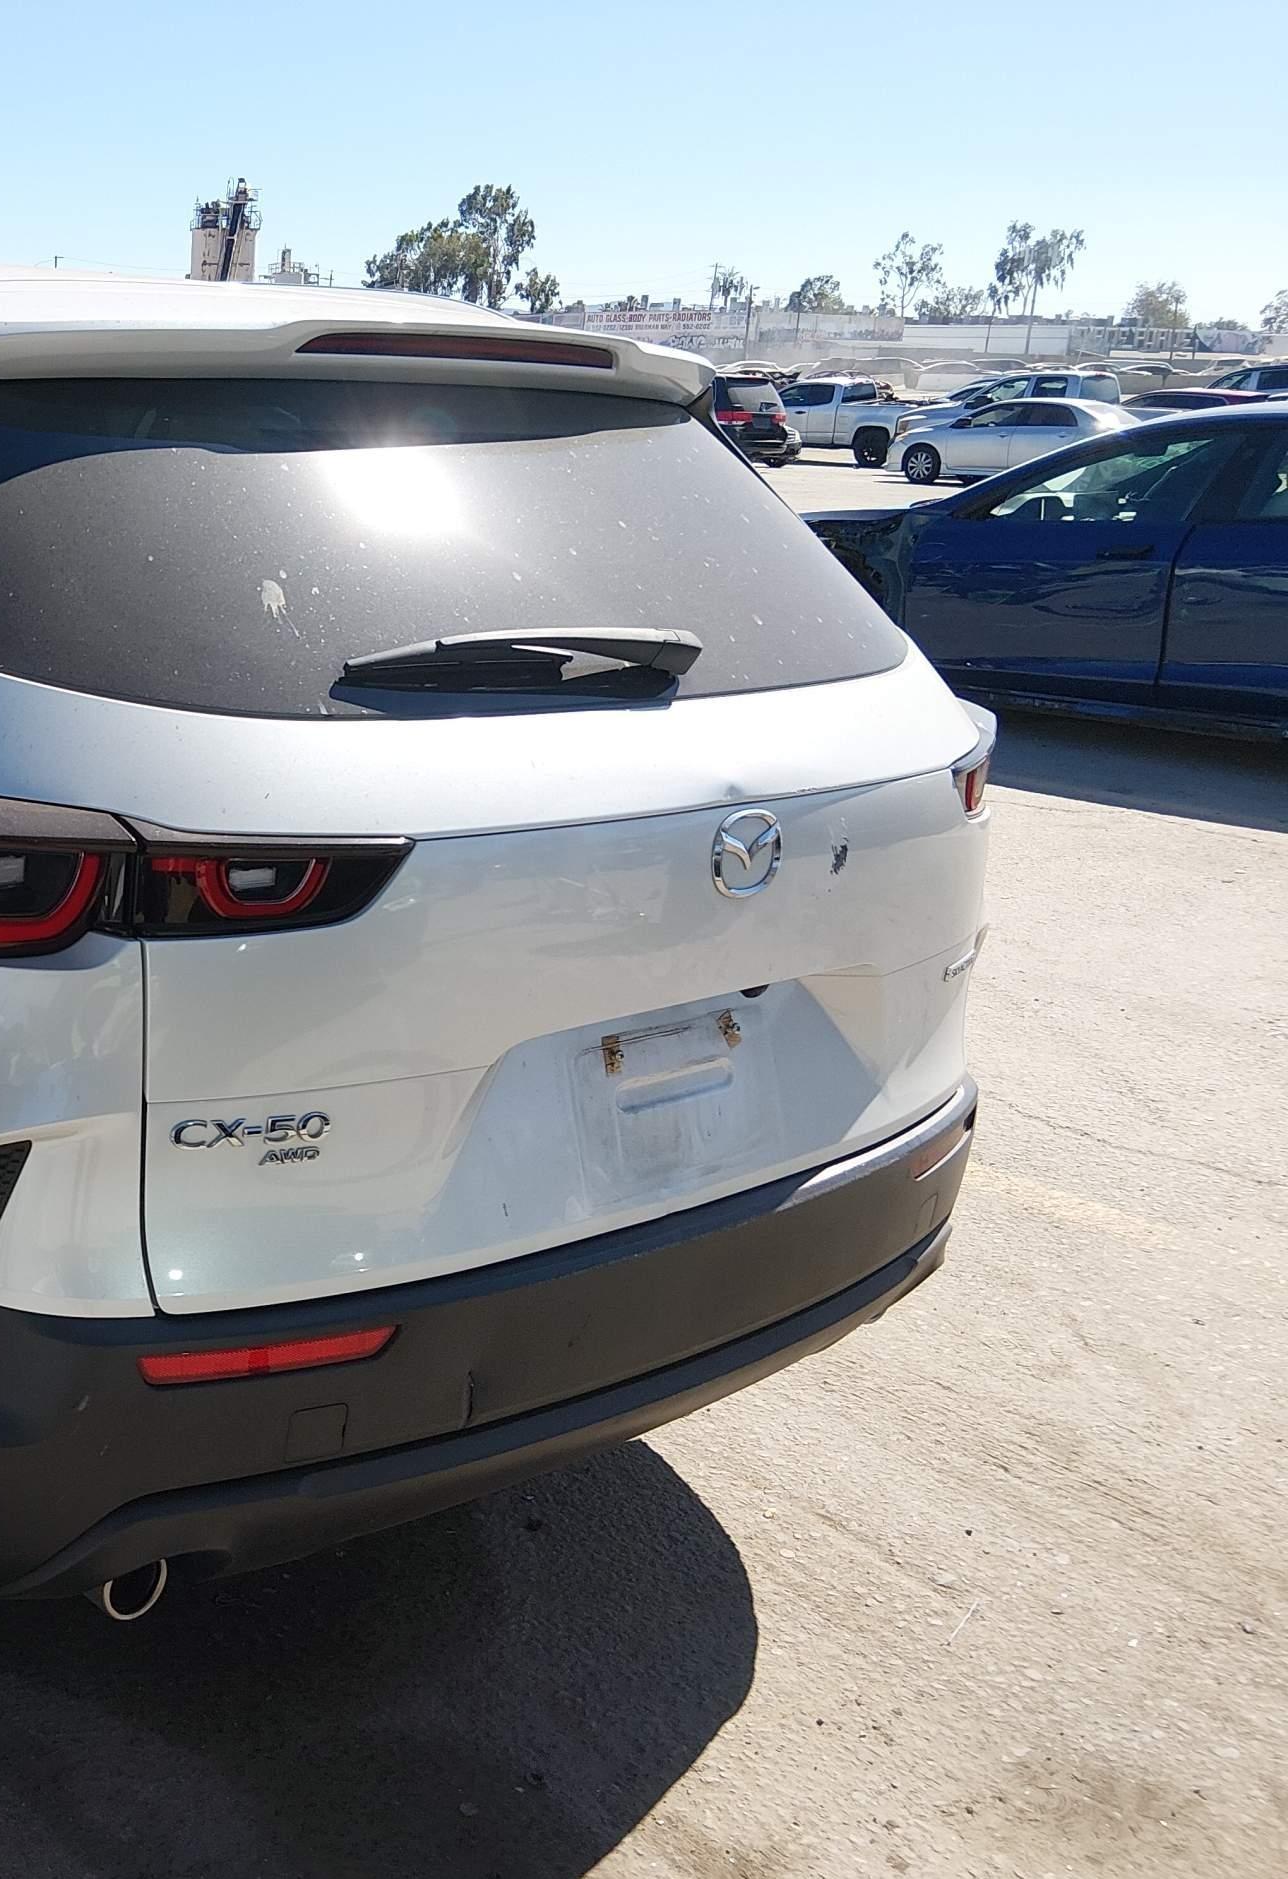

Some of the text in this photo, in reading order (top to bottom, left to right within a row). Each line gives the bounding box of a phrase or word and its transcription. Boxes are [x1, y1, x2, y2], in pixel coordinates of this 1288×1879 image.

[586, 314, 603, 322] AUTO
[169, 1111, 332, 1150] CX-50
[258, 1146, 320, 1166] AWD
